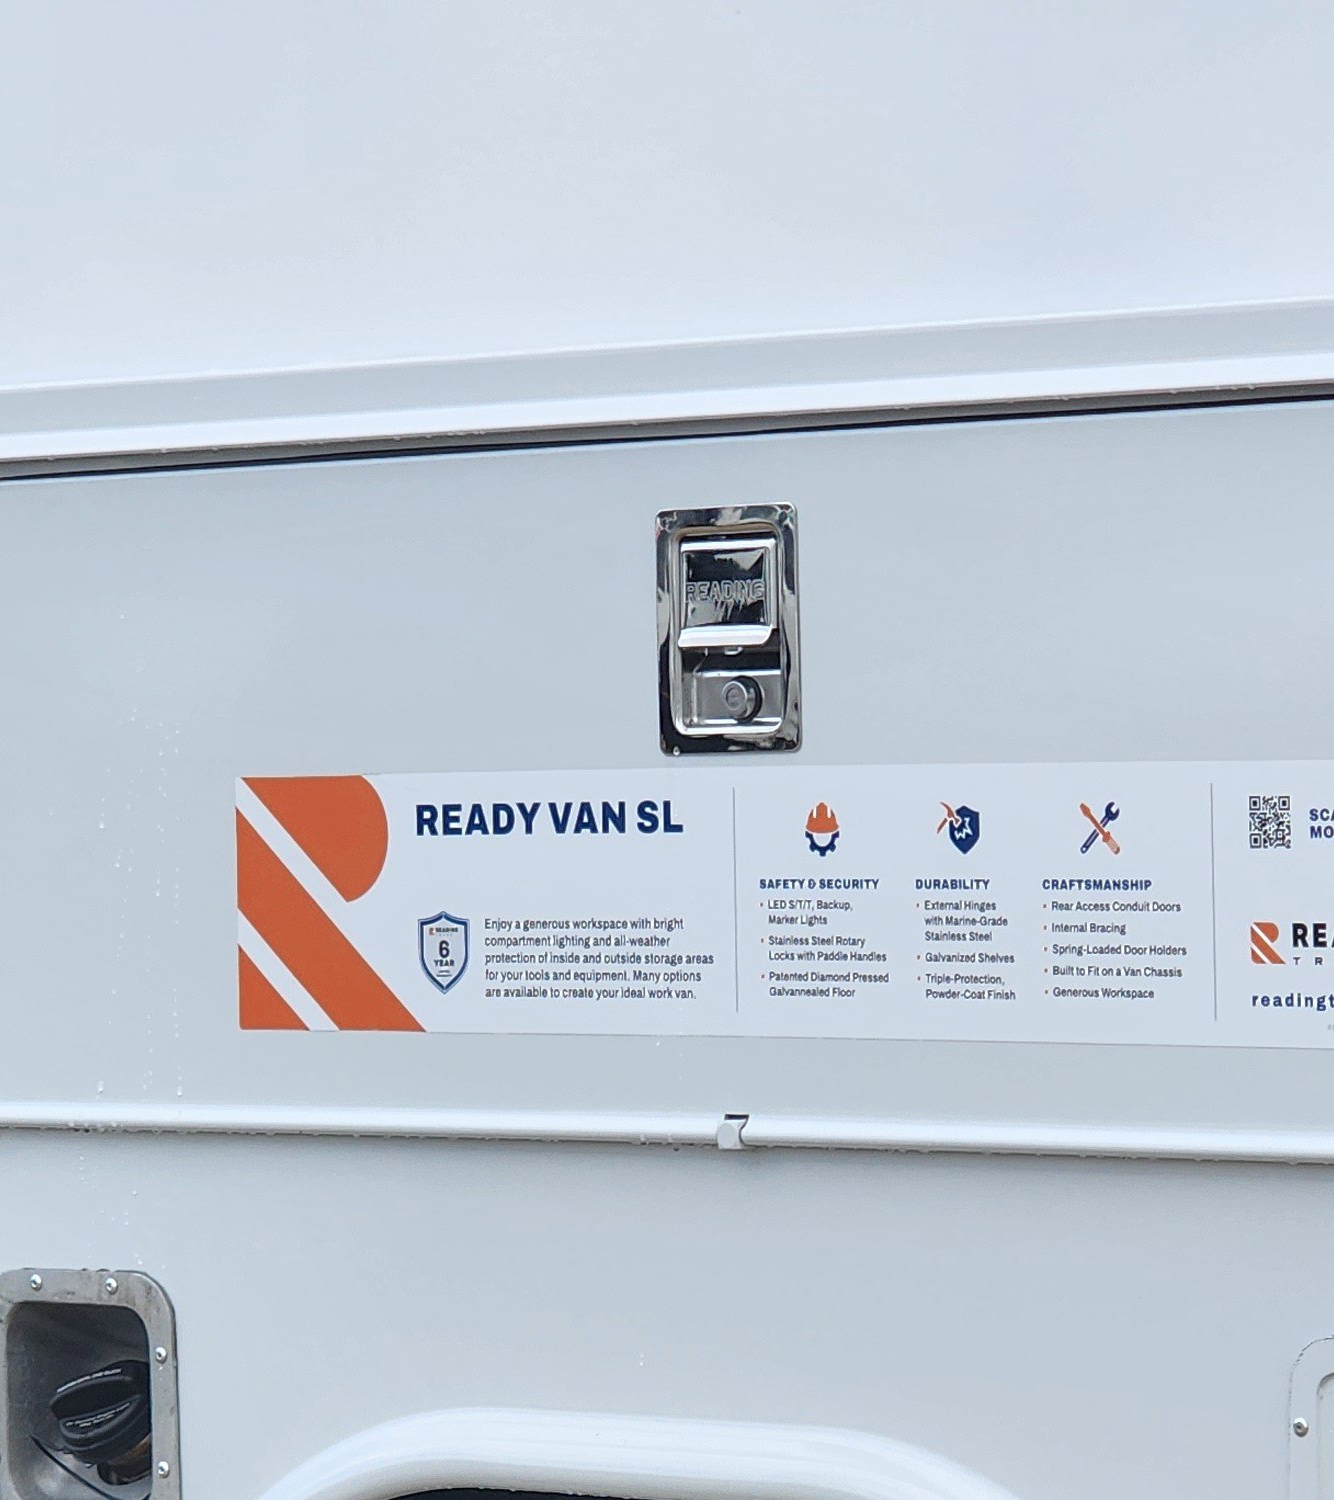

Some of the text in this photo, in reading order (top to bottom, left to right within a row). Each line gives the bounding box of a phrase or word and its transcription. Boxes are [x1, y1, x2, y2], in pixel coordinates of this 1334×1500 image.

[685, 578, 766, 603] READING
[416, 801, 683, 836] READY VAN SL
[760, 879, 805, 889] SAFETY
[819, 879, 879, 889] SECURITY
[916, 879, 989, 889] DURABILITY
[1043, 879, 1151, 890] CRAFTSMANSHIP
[768, 900, 786, 909] LED
[925, 900, 996, 912] External Hinges
[1052, 901, 1181, 912] Rear Access Conduit Doors
[485, 918, 683, 932] Enjoy a generous workspace with bright
[769, 915, 827, 927] Marker Lights
[925, 916, 1007, 926] with Marine-Grade
[1052, 923, 1126, 935] Internal Bracing
[925, 931, 992, 941] Stainless Steel
[485, 935, 670, 949] compartment lighting and all-weather
[769, 936, 865, 948] Stainless Steel Rotary
[439, 940, 450, 959] 6
[1053, 944, 1187, 956] Spring-Loaded Door Holders
[485, 952, 714, 966] protection of inside and outside storage areas
[769, 951, 886, 961] Locks with Paddle Handles
[926, 953, 1015, 963] Galvanized Shelves
[434, 959, 455, 967] YEAR
[486, 969, 498, 980] for
[501, 971, 523, 983] your
[526, 970, 550, 980] tools
[553, 970, 571, 980] and
[633, 970, 660, 984] Many
[663, 970, 701, 983] options
[769, 971, 889, 982] Patented Diamond Pressed
[1053, 966, 1182, 977] Built to Fit on a Van Chassis
[486, 989, 501, 997] are
[504, 986, 547, 997] available
[550, 987, 560, 998] to
[563, 989, 593, 998] create
[596, 989, 619, 1000] your
[621, 987, 645, 998] ideal
[648, 987, 672, 998] work
[770, 987, 855, 997] Galvannealed Floor
[926, 989, 1015, 999] Powder-Coat Finish
[1053, 987, 1154, 999] Generous Workspace
